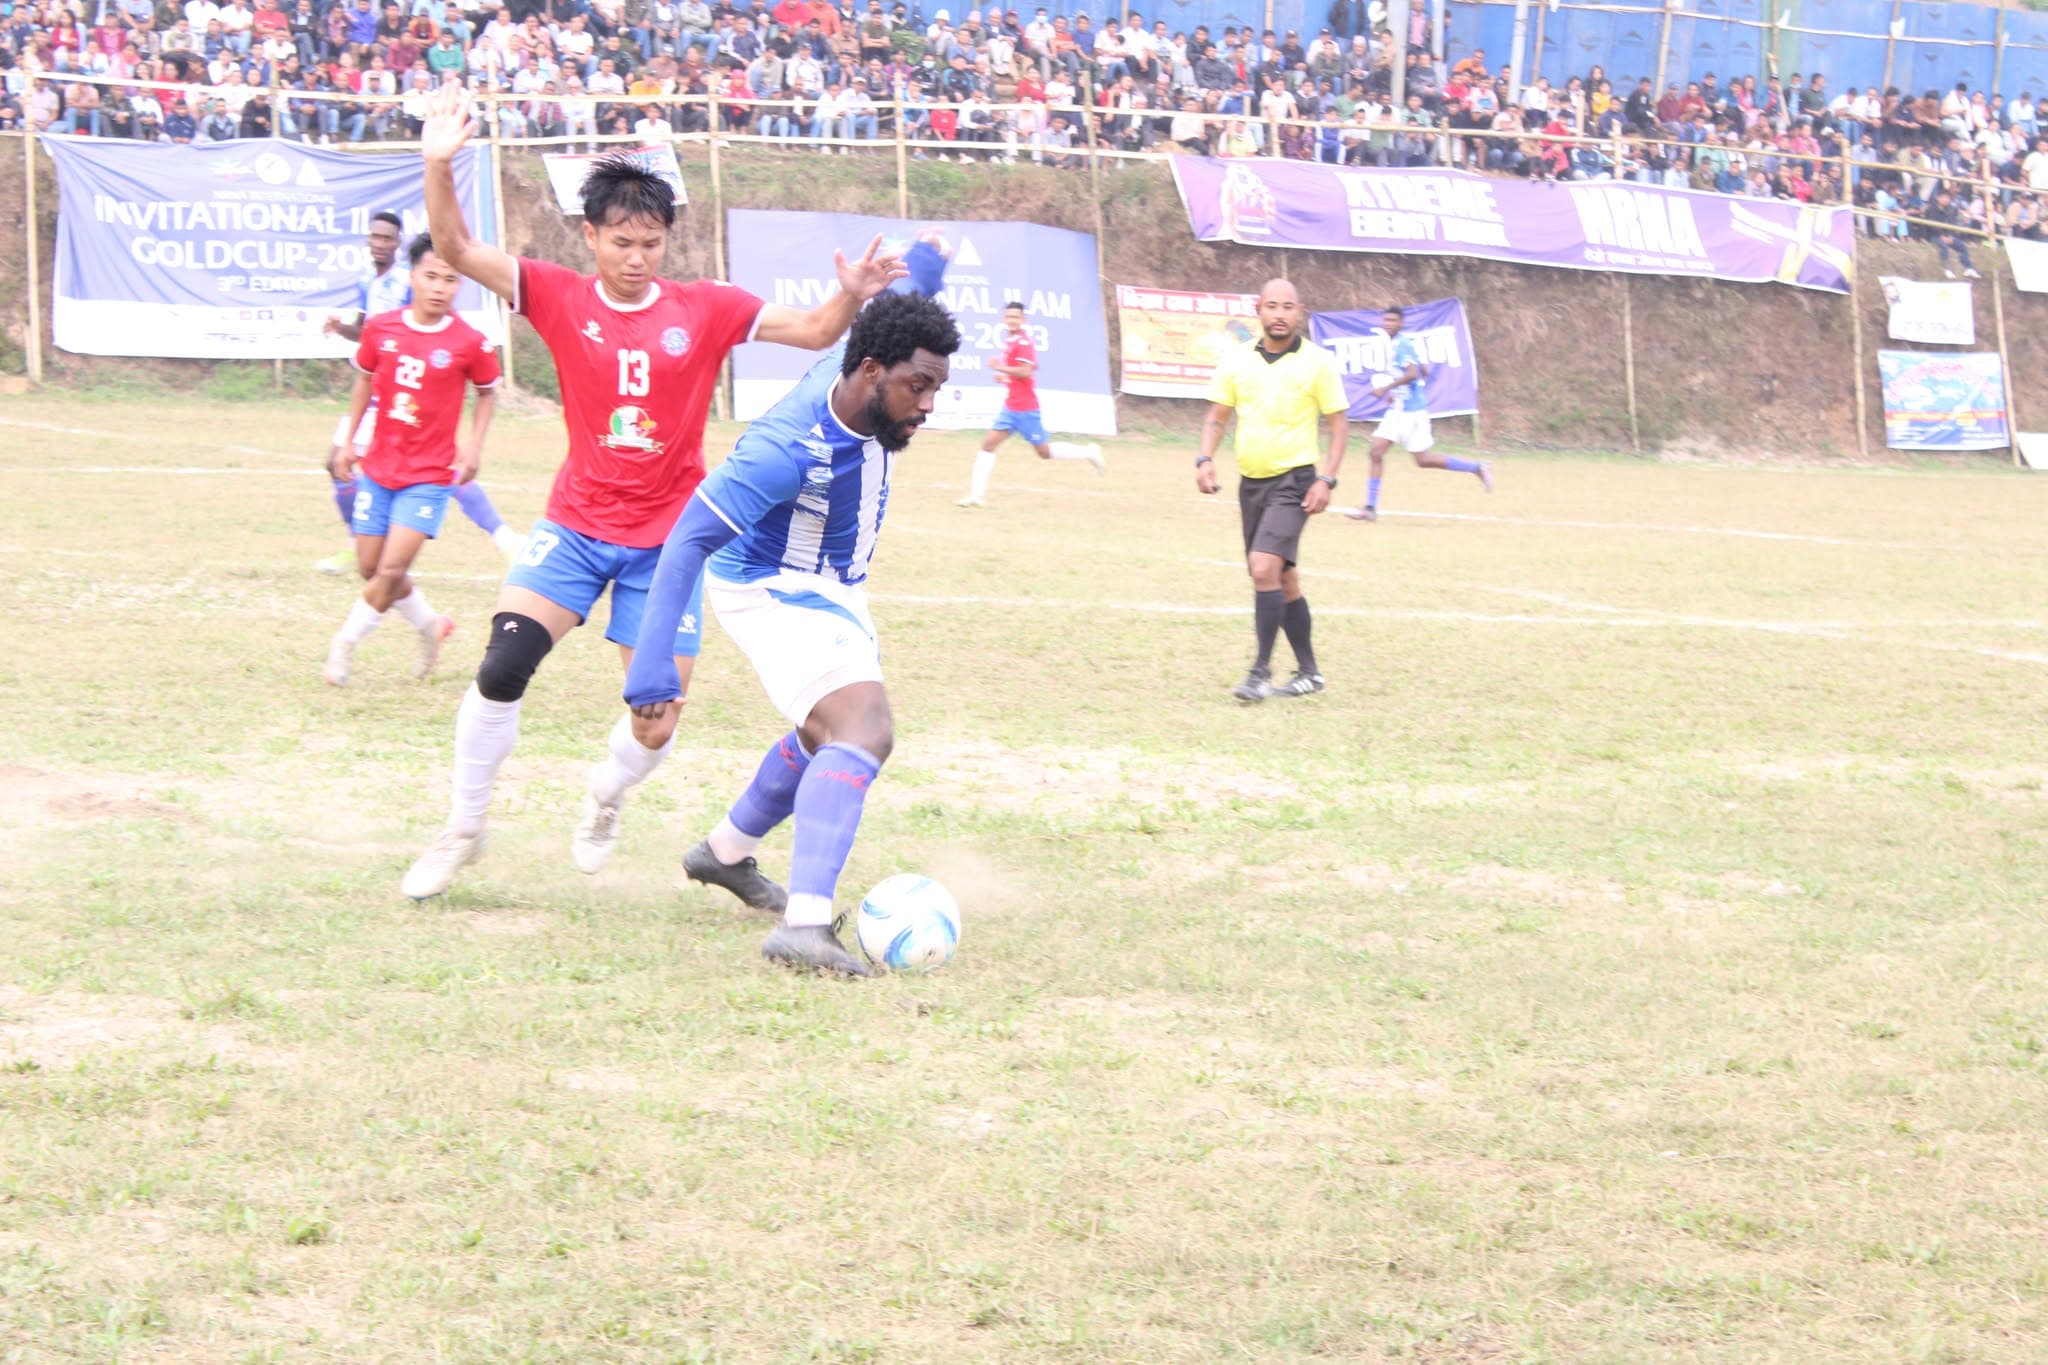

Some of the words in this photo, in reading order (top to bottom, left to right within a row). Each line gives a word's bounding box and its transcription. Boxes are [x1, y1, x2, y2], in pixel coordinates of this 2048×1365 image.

[94, 193, 343, 234] INVITATIONAL
[350, 207, 429, 235] ILM
[1334, 171, 1504, 222] XTREME
[131, 236, 370, 272] GOLDCUP-20
[249, 276, 328, 291] EDITION
[395, 355, 426, 389] 22
[617, 349, 650, 397] 13
